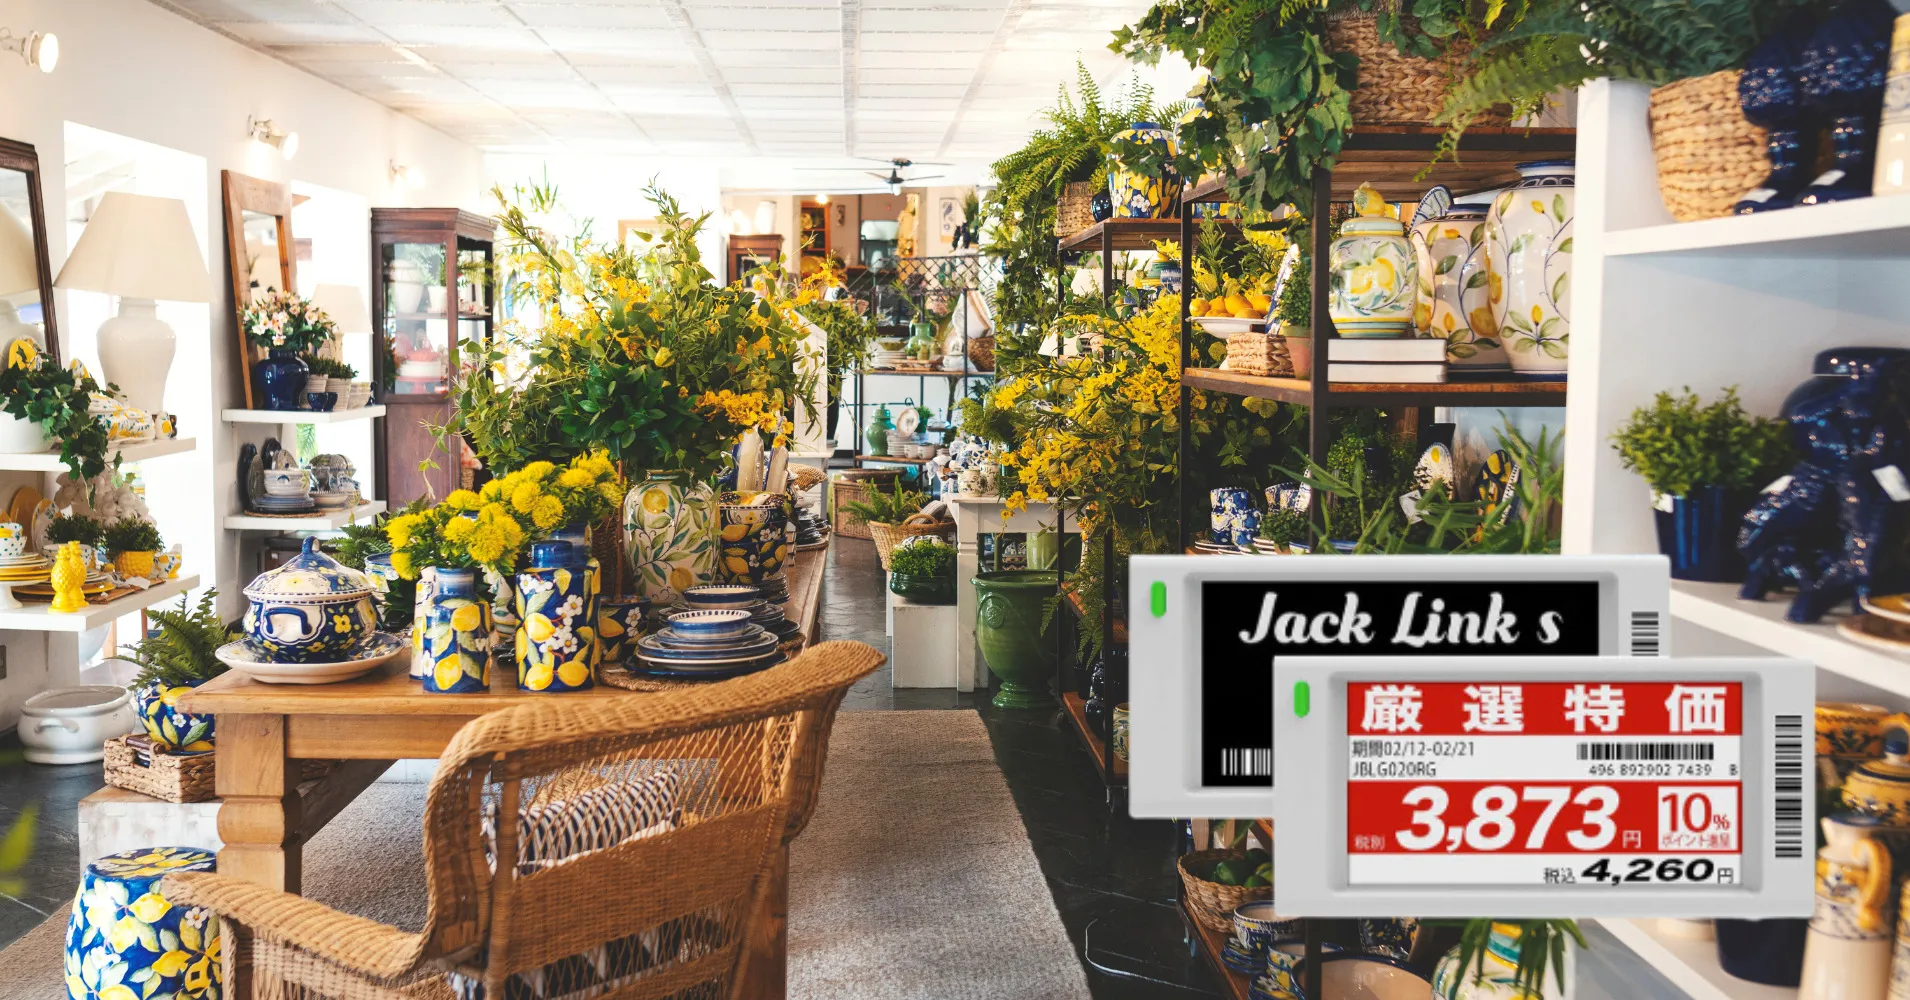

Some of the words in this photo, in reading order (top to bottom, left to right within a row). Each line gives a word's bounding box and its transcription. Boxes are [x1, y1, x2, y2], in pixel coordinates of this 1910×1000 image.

[1239, 592, 1376, 644] Jack
[1391, 592, 1520, 648] Link
[1395, 785, 1620, 852] 3,873
[1622, 830, 1642, 849] 円
[1581, 858, 1714, 886] 4,260
[1717, 868, 1734, 884] 円
